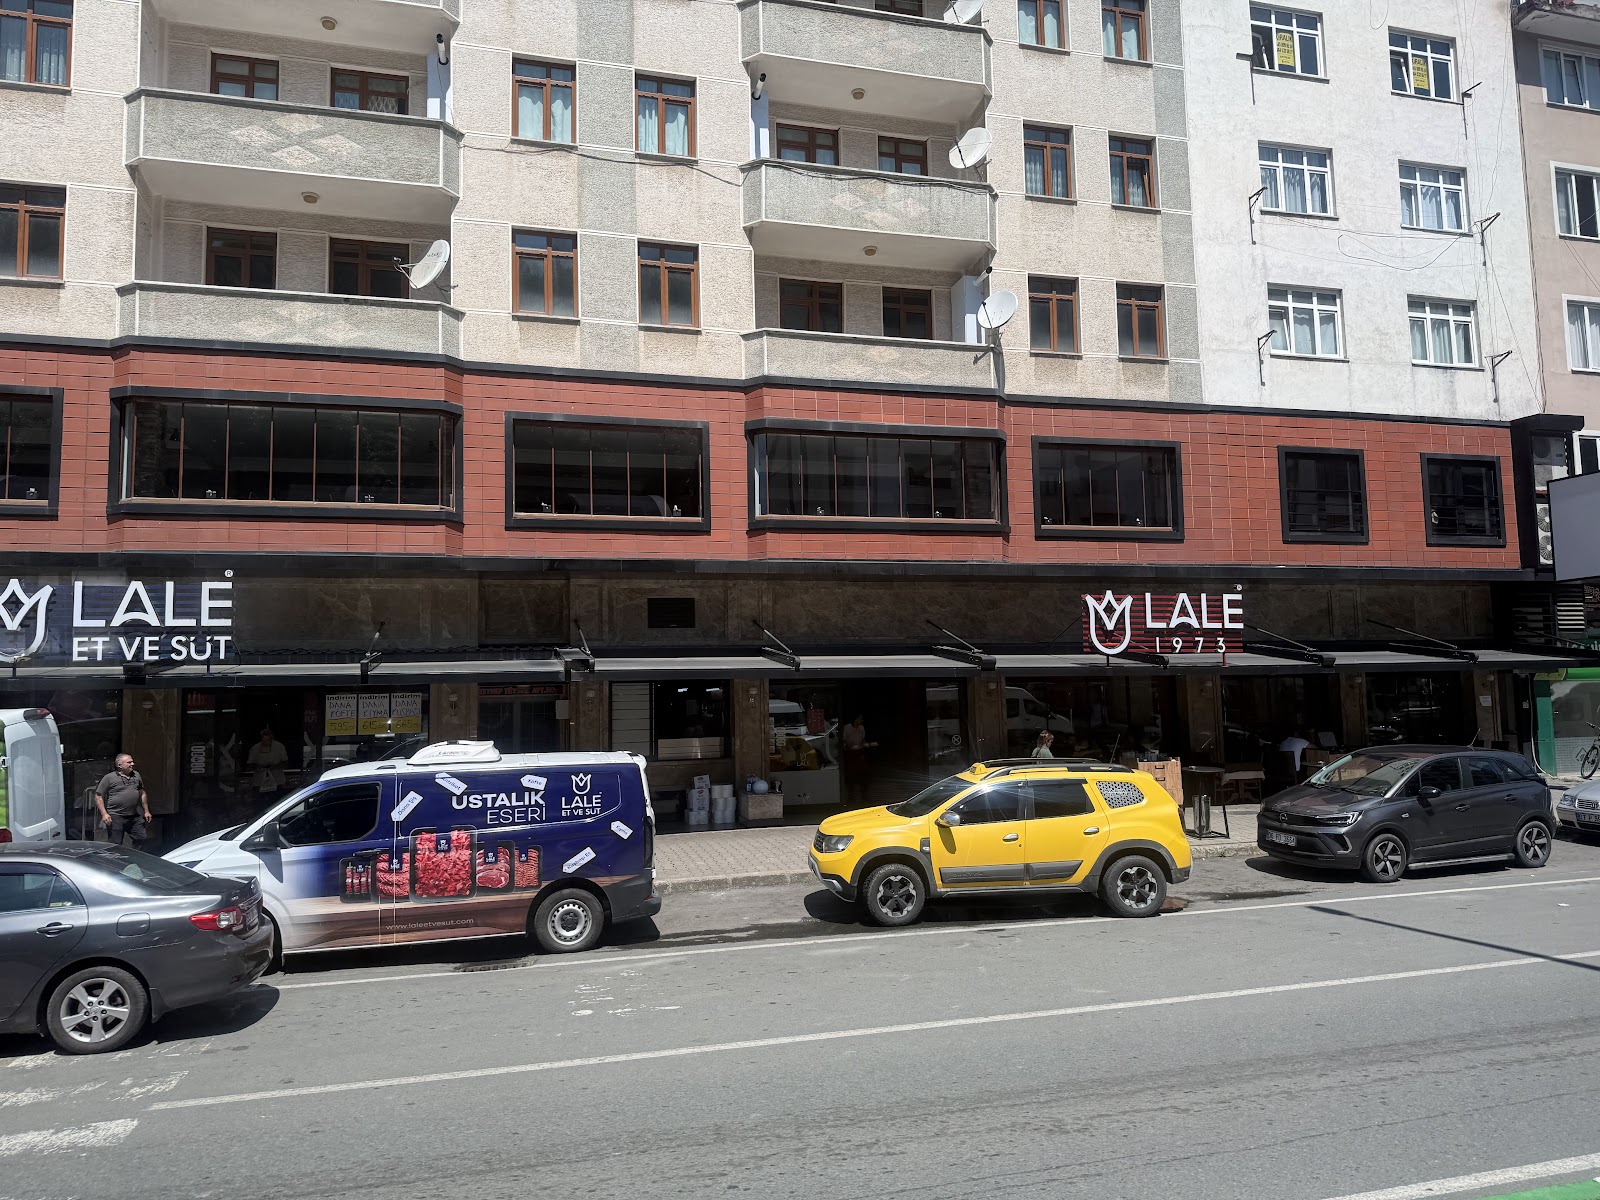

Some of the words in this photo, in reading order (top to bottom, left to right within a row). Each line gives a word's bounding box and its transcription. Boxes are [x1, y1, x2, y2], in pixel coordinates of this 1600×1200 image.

[72, 581, 233, 627] LALE
[1145, 592, 1244, 629] LALE
[72, 637, 110, 661] ET
[118, 637, 160, 660] VE
[1155, 637, 1226, 653] 1973
[451, 790, 546, 810] USTALIK
[561, 795, 602, 809] LALE
[487, 804, 546, 824] ESERİ
[385, 917, 474, 931] www.laleetvesut.com
